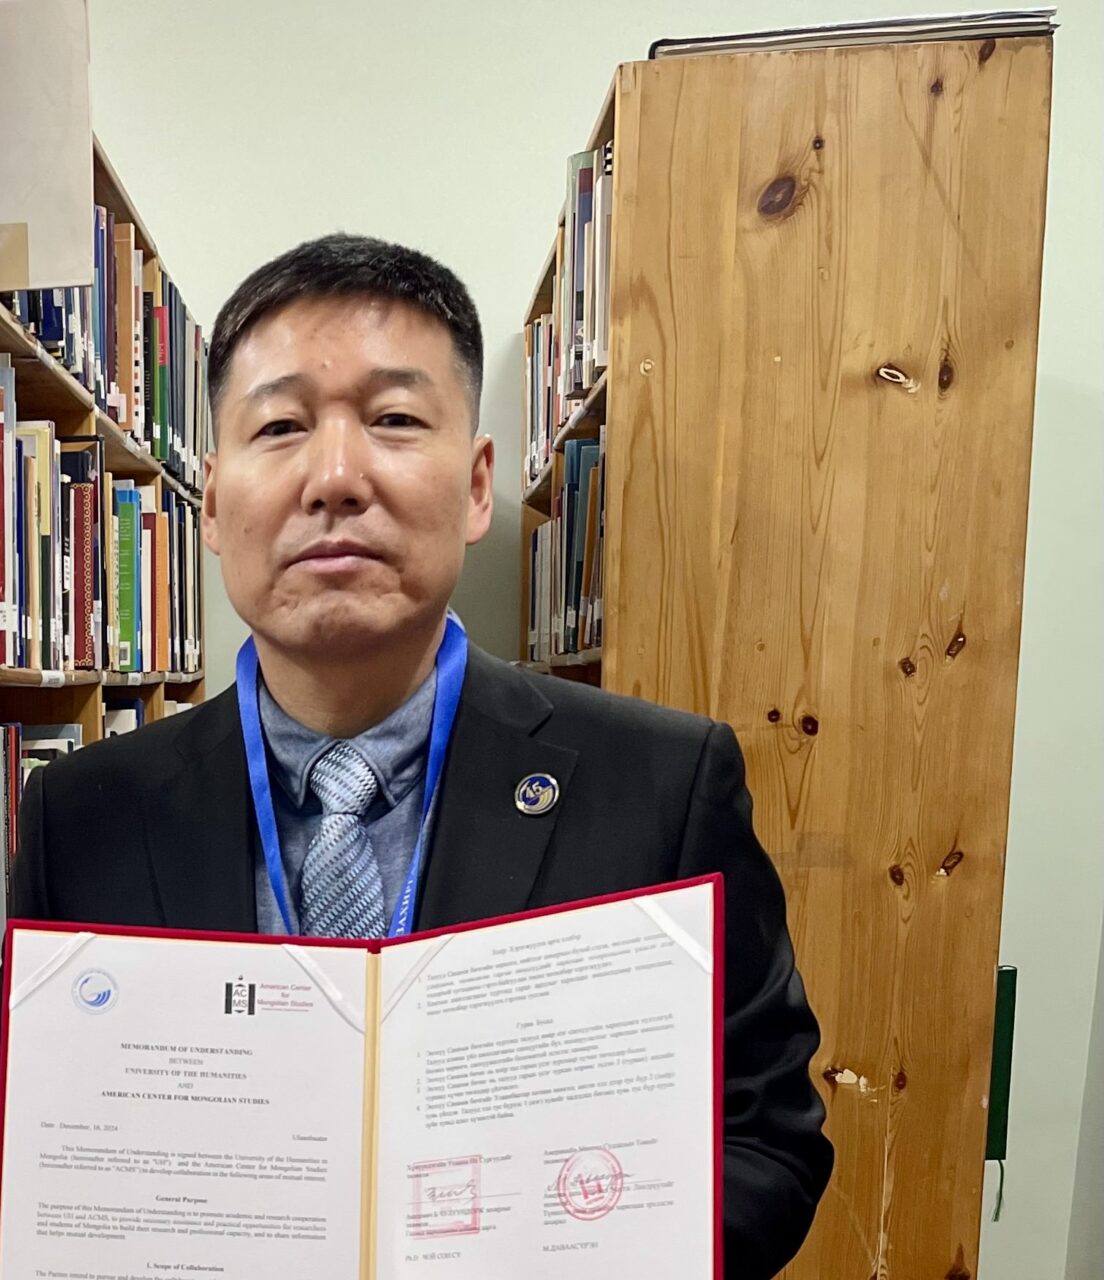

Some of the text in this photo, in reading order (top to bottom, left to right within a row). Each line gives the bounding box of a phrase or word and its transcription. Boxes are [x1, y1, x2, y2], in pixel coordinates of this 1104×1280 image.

[233, 989, 248, 998] AC
[120, 1043, 176, 1051] MEMORANDUM
[190, 1046, 252, 1055] UNDERSTANDING
[168, 1057, 203, 1065] BETWEEN
[125, 1067, 169, 1075] UNIVERSITY
[199, 1071, 246, 1079] HUMANITIES
[102, 1090, 140, 1098] AMERICAN
[142, 1092, 171, 1100] CENTER
[190, 1095, 236, 1103] MONGOLIAN
